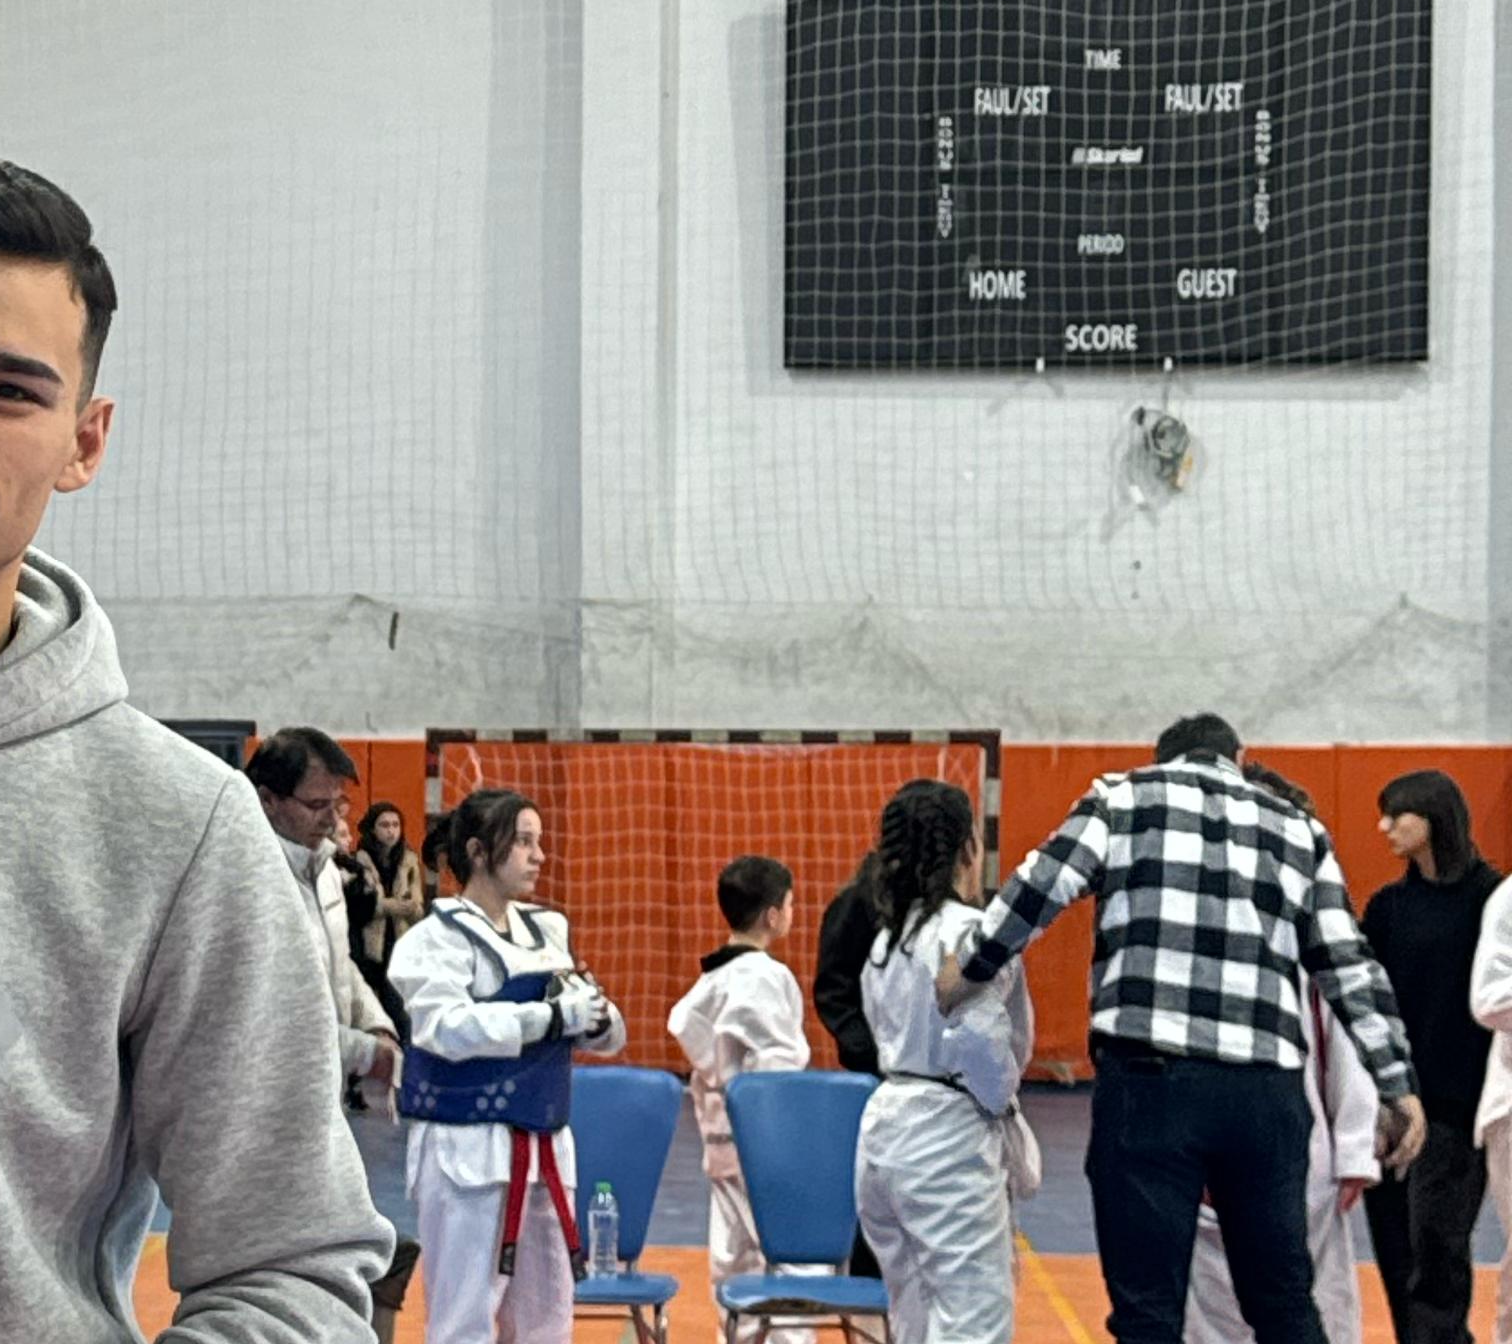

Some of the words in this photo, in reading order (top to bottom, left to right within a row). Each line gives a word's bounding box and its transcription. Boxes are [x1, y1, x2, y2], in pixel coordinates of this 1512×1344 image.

[1085, 48, 1121, 70] TIME
[974, 85, 1051, 116] FAUL/SET
[1165, 82, 1244, 112] FAUL/SET
[1077, 234, 1125, 255] PERIOD
[969, 270, 1027, 300] HOME
[1177, 268, 1237, 299] GUEST
[1065, 324, 1138, 352] SCORE
